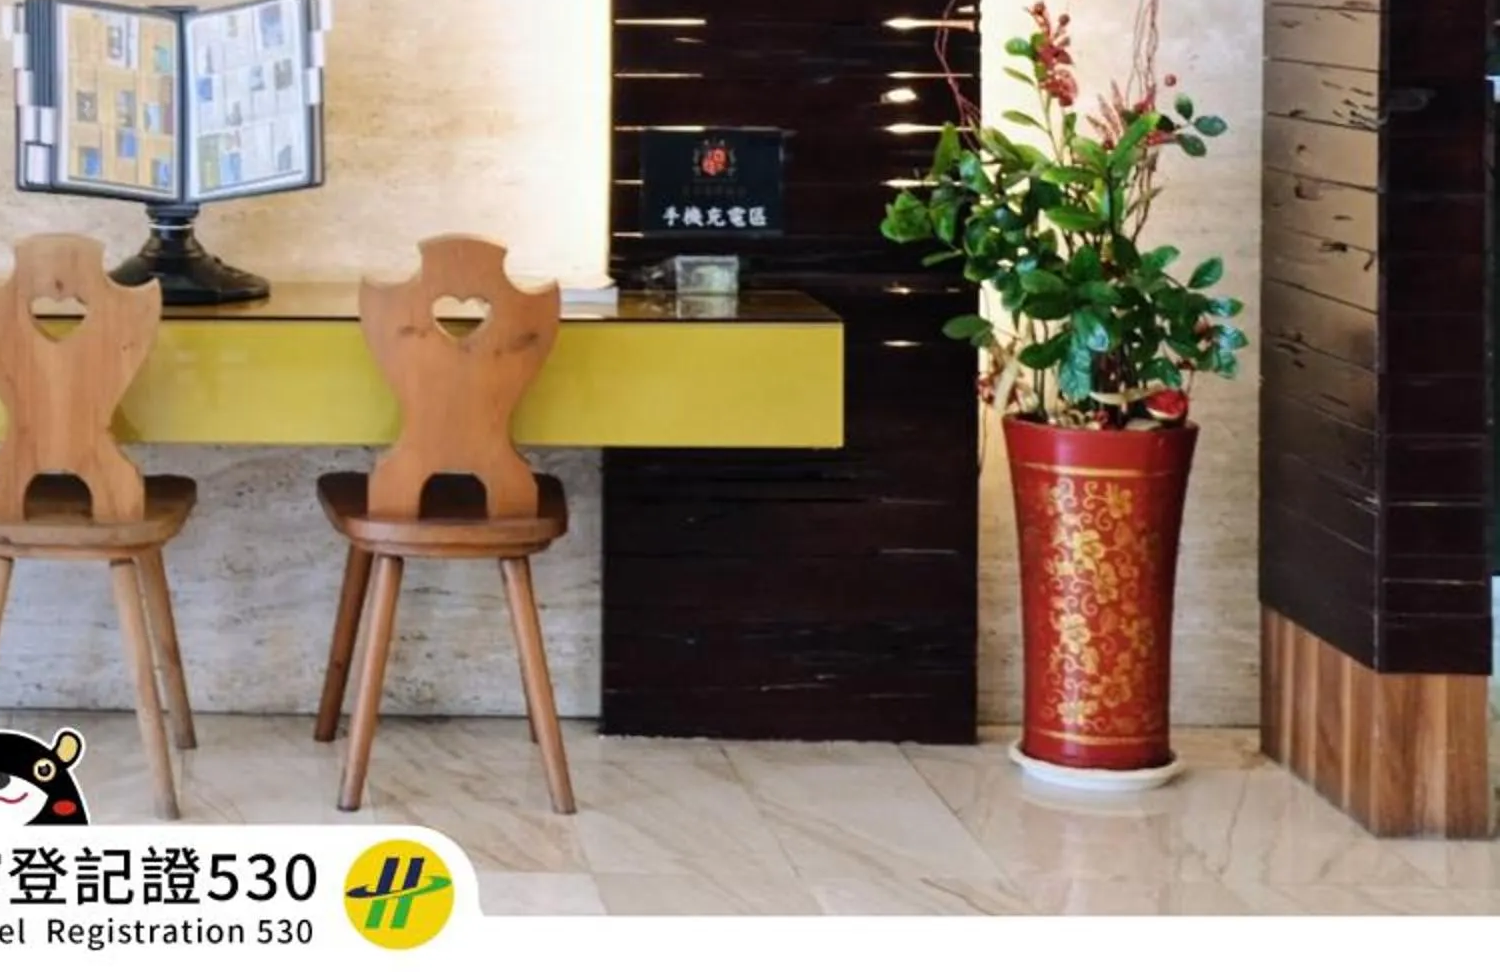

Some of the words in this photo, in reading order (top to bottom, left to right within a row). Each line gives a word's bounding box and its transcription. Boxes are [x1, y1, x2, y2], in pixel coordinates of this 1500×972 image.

[662, 206, 767, 227] 手機充電區
